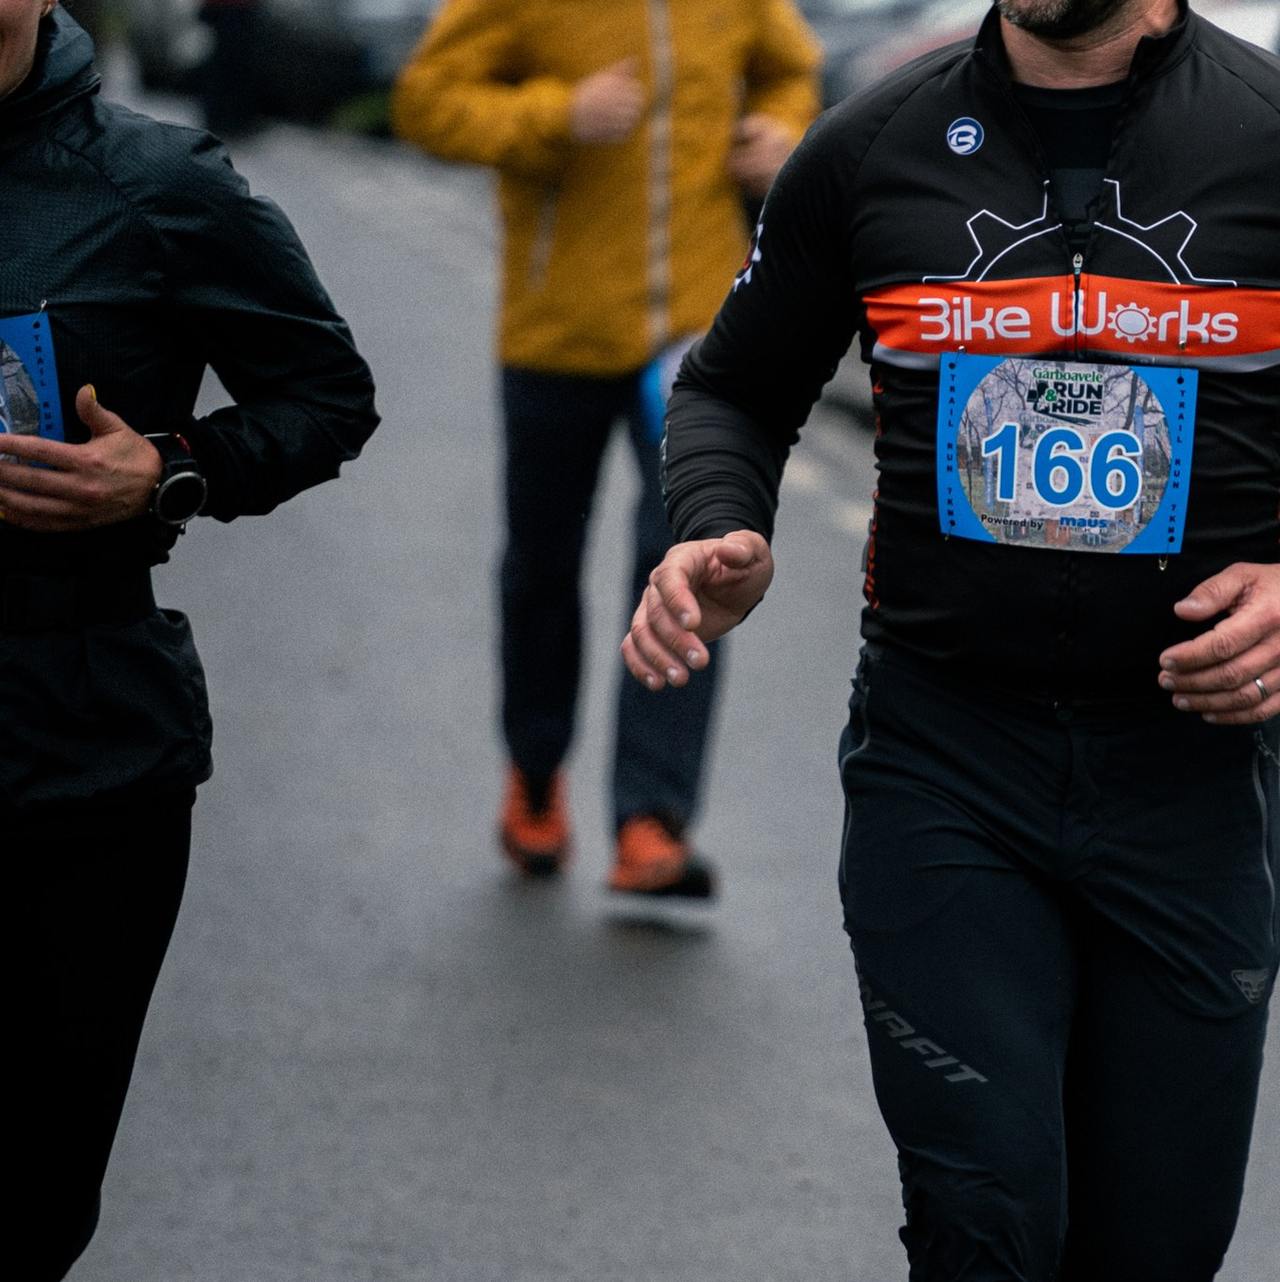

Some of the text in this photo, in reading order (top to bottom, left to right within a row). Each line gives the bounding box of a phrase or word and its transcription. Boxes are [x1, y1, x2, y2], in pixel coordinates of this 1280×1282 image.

[918, 290, 1238, 344] Bike Works
[948, 373, 957, 428] TRAIL
[1045, 388, 1057, 402] &
[1053, 381, 1103, 400] RUN
[1051, 399, 1102, 416] RIDE
[1176, 389, 1186, 444] TRAIL
[946, 441, 954, 473] RUN
[983, 423, 1141, 510] 166
[1172, 458, 1182, 489] RUN
[980, 513, 1027, 528] Powered
[1030, 518, 1044, 531] by
[1059, 516, 1108, 528] maus
